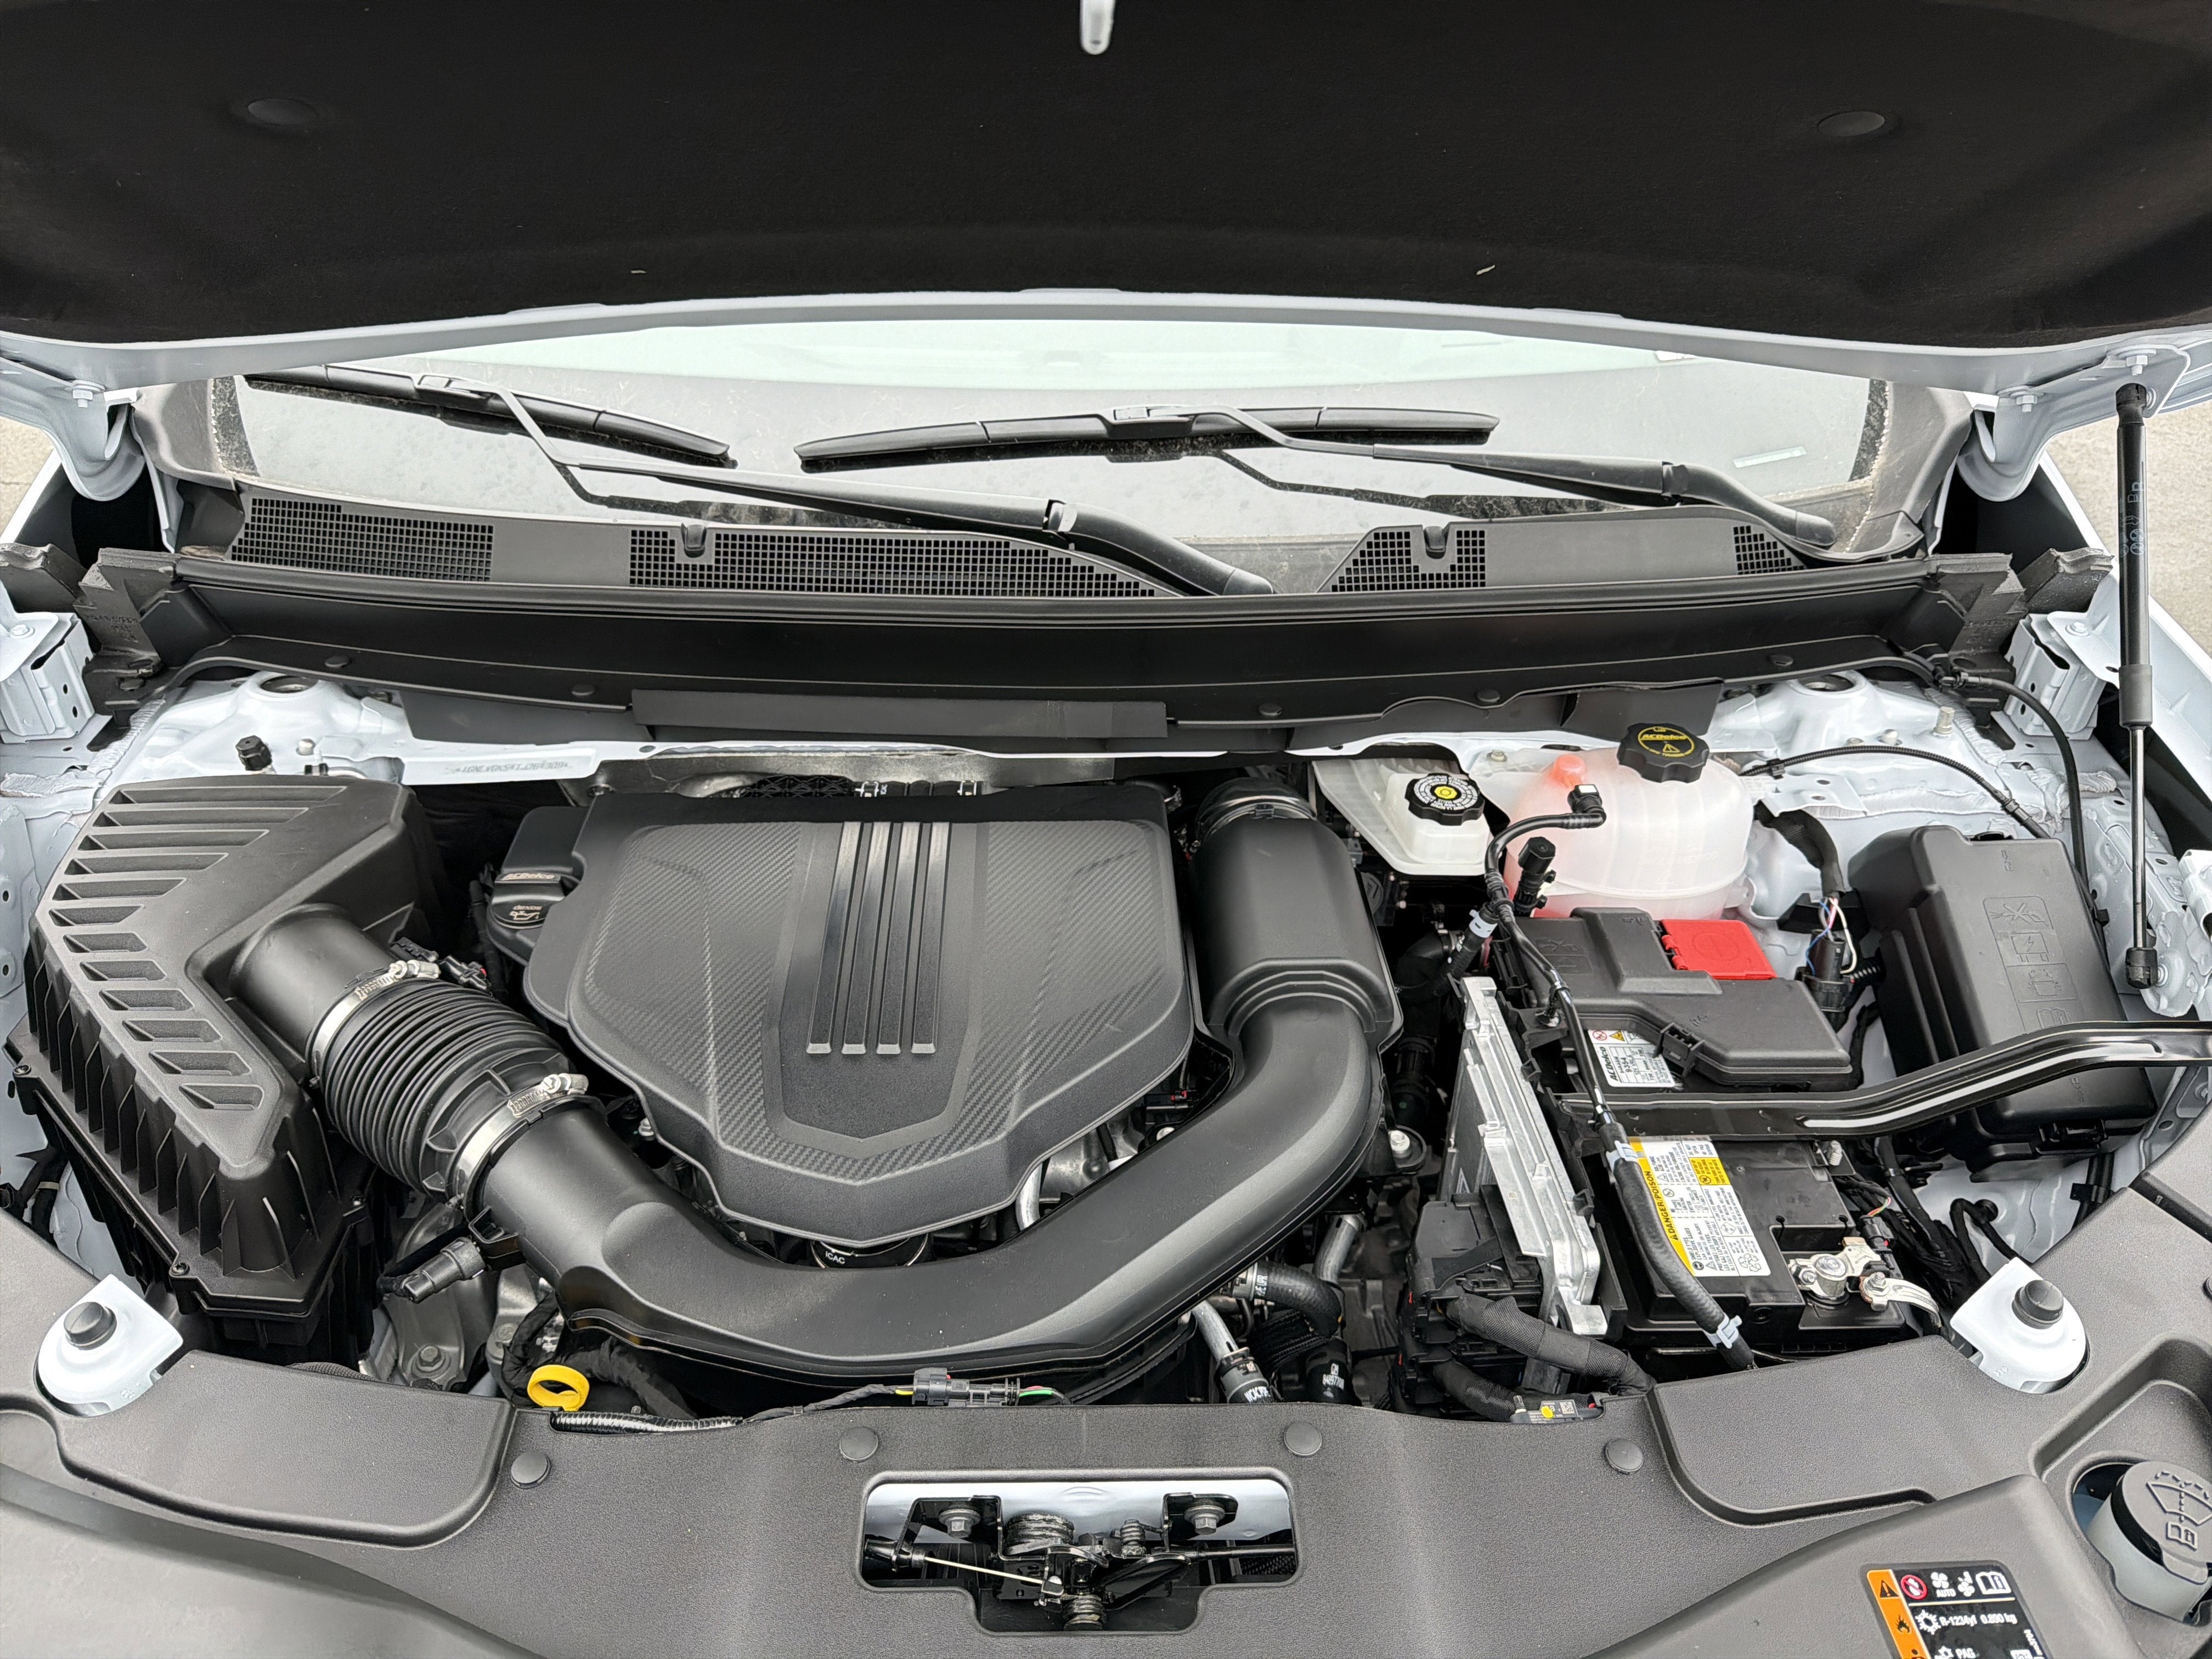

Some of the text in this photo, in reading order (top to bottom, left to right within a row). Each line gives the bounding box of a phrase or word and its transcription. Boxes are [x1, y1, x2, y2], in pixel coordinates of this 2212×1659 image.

[1599, 1046, 1619, 1082] ACDelco
[1644, 1171, 1675, 1235] DANGER/POISON
[825, 1251, 846, 1265] ICAC
[1330, 1363, 1339, 1375] GM
[1936, 1589, 1956, 1598] AUTO
[1940, 1613, 1977, 1627] R-1234yf
[2005, 1613, 2018, 1624] kg
[1956, 1648, 1976, 1659] PAG
